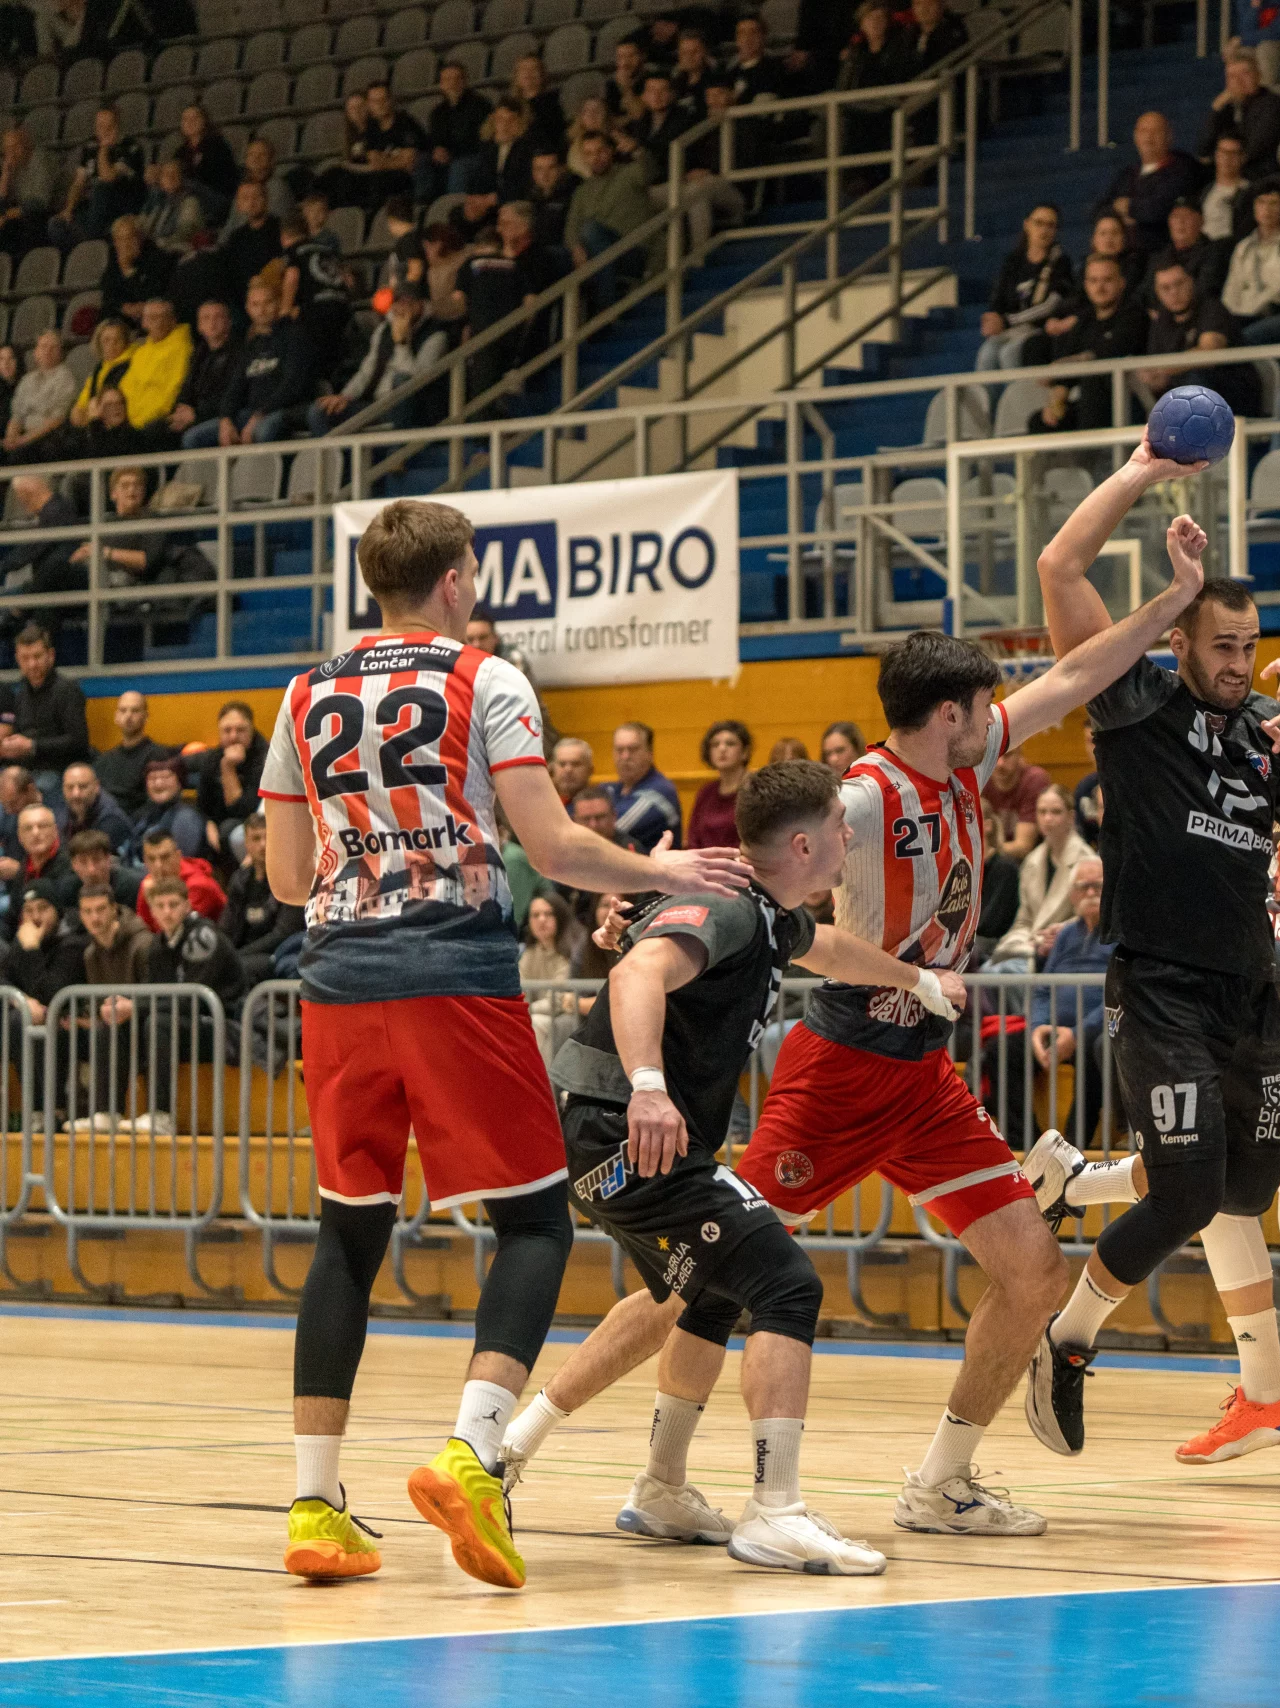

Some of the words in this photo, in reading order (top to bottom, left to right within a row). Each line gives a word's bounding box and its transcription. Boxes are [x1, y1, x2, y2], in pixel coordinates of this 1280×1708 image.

[568, 526, 716, 598] BIRO
[362, 645, 452, 660] Automobil
[565, 616, 713, 652] transformer
[359, 655, 415, 672] Lončar
[303, 684, 450, 802] 22
[338, 814, 476, 859] Bomark
[892, 811, 942, 860] 27
[1150, 1082, 1198, 1133] 97
[1160, 1133, 1199, 1146] Kempa
[754, 1438, 771, 1484] Kempa
